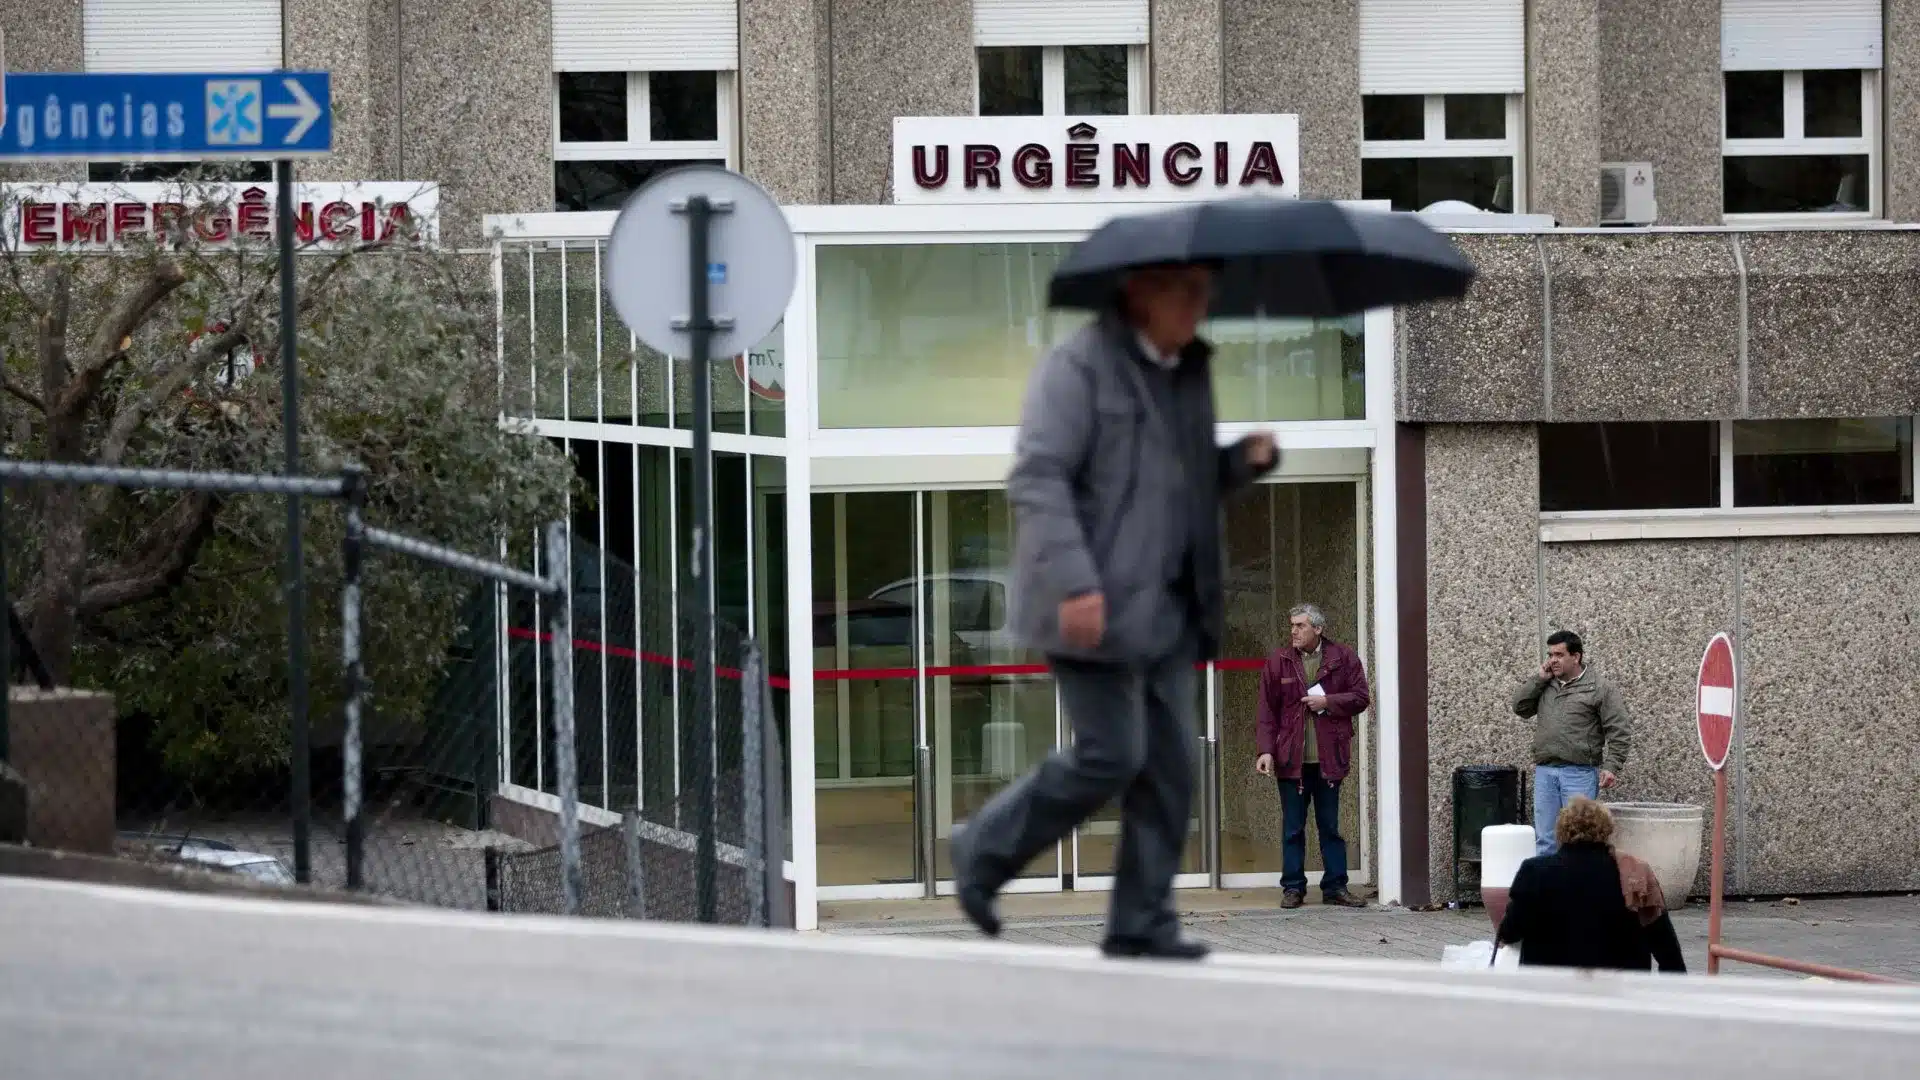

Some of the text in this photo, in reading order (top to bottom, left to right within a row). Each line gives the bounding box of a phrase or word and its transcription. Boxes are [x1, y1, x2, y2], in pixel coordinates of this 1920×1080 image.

[17, 93, 185, 147] gências
[911, 121, 1285, 189] URGÊNCIA
[23, 186, 420, 243] EMERGÊNCIA
